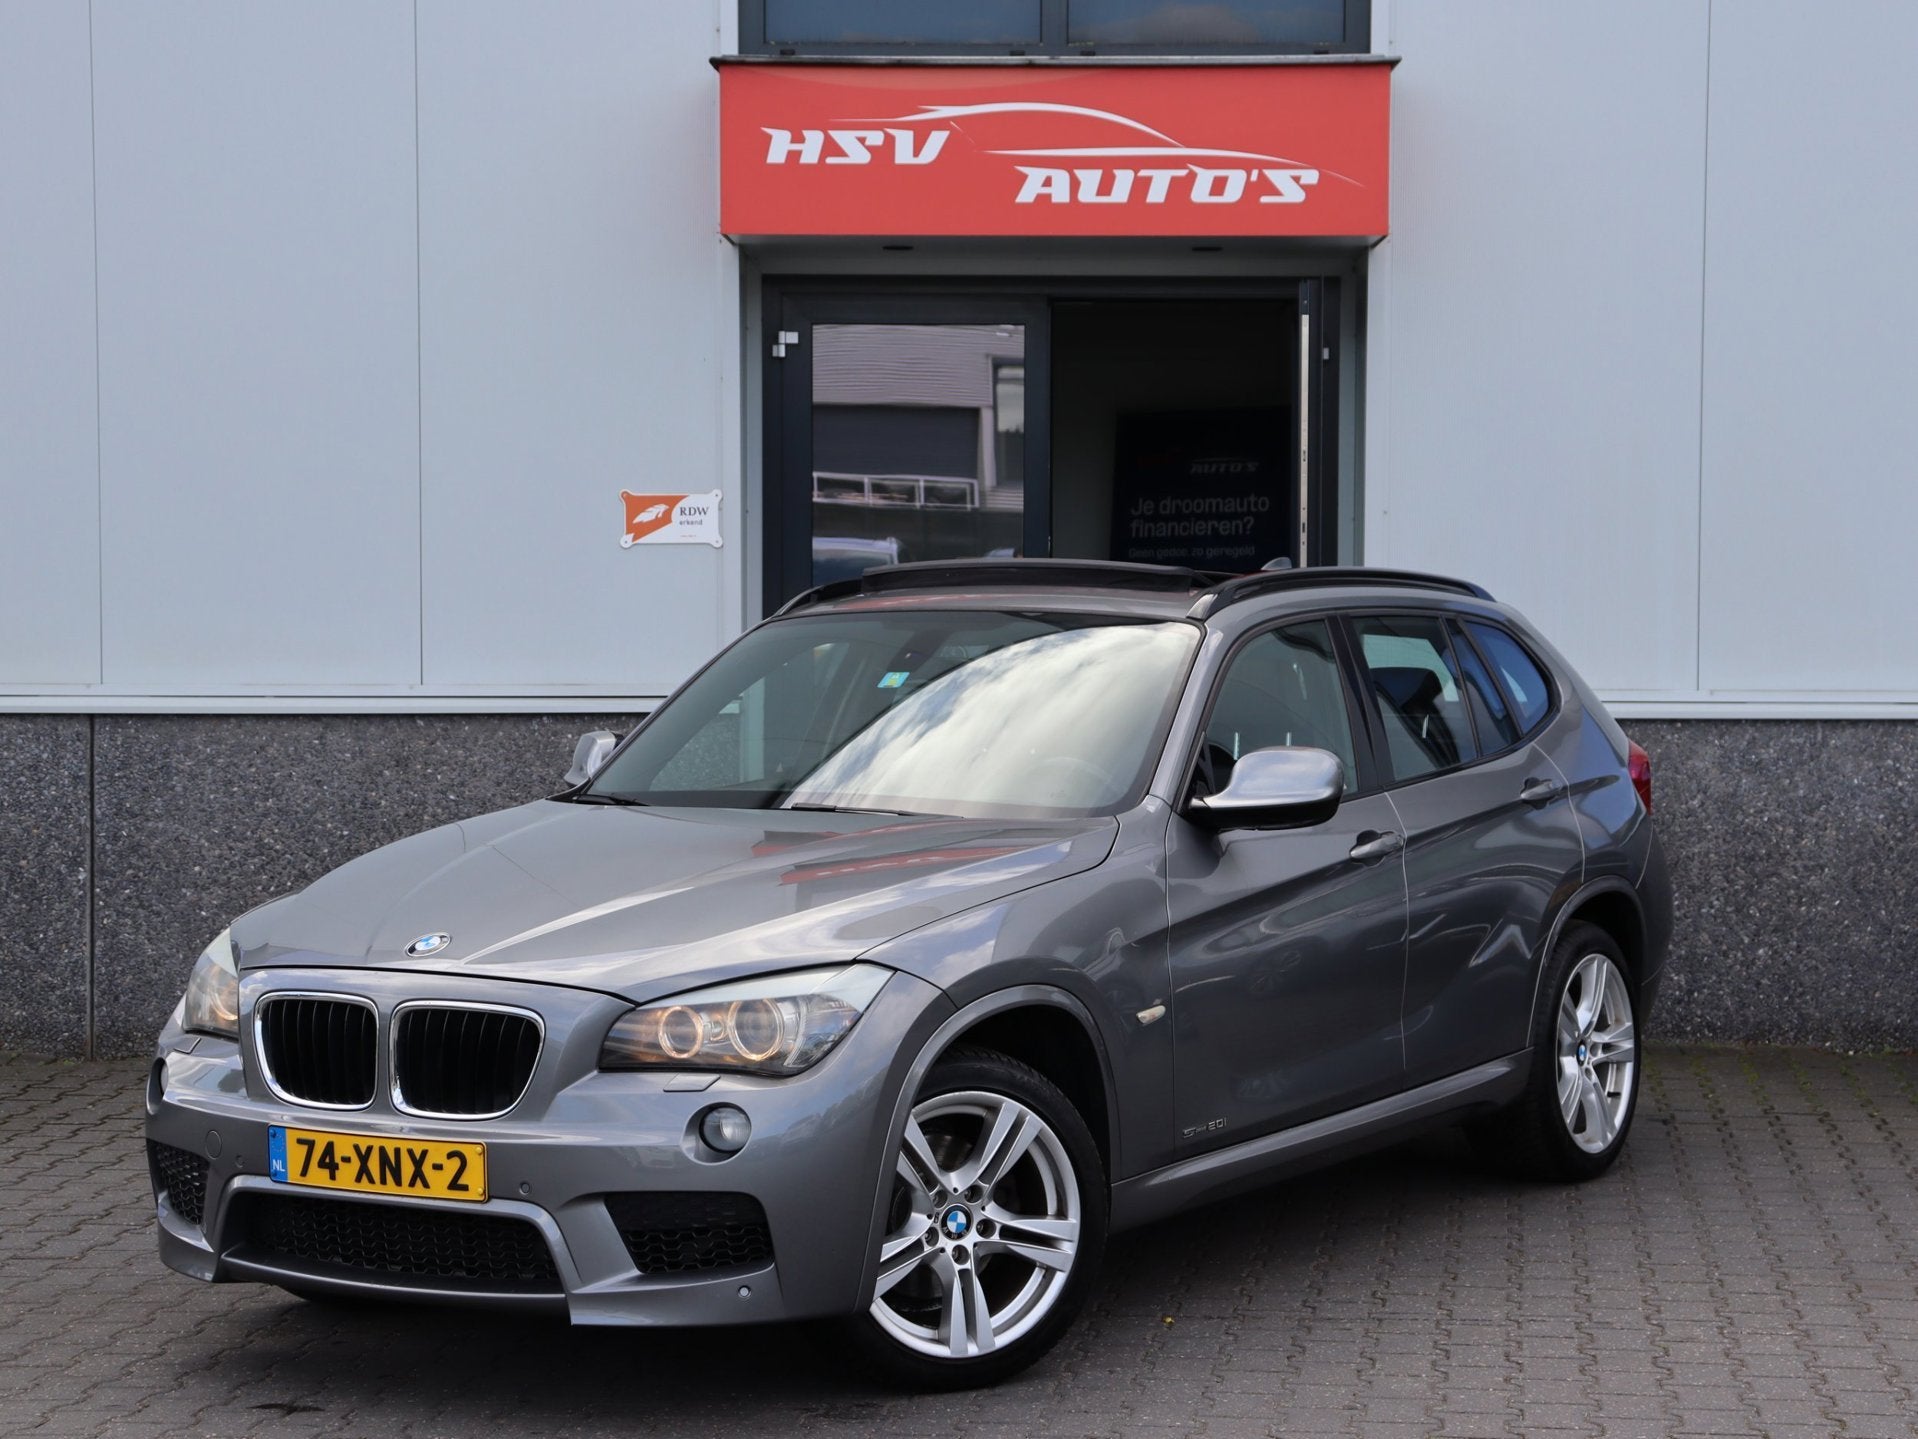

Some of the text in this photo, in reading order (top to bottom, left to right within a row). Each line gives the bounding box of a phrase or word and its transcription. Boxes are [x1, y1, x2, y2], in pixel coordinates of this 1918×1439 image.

[760, 126, 950, 165] HSV
[1013, 163, 1320, 204] AUTO'S
[679, 506, 709, 516] RDW
[1130, 494, 1270, 516] Je droomauto
[1130, 516, 1255, 538] financieren?
[272, 1160, 286, 1172] NL
[296, 1137, 470, 1192] 74-XNX-2
